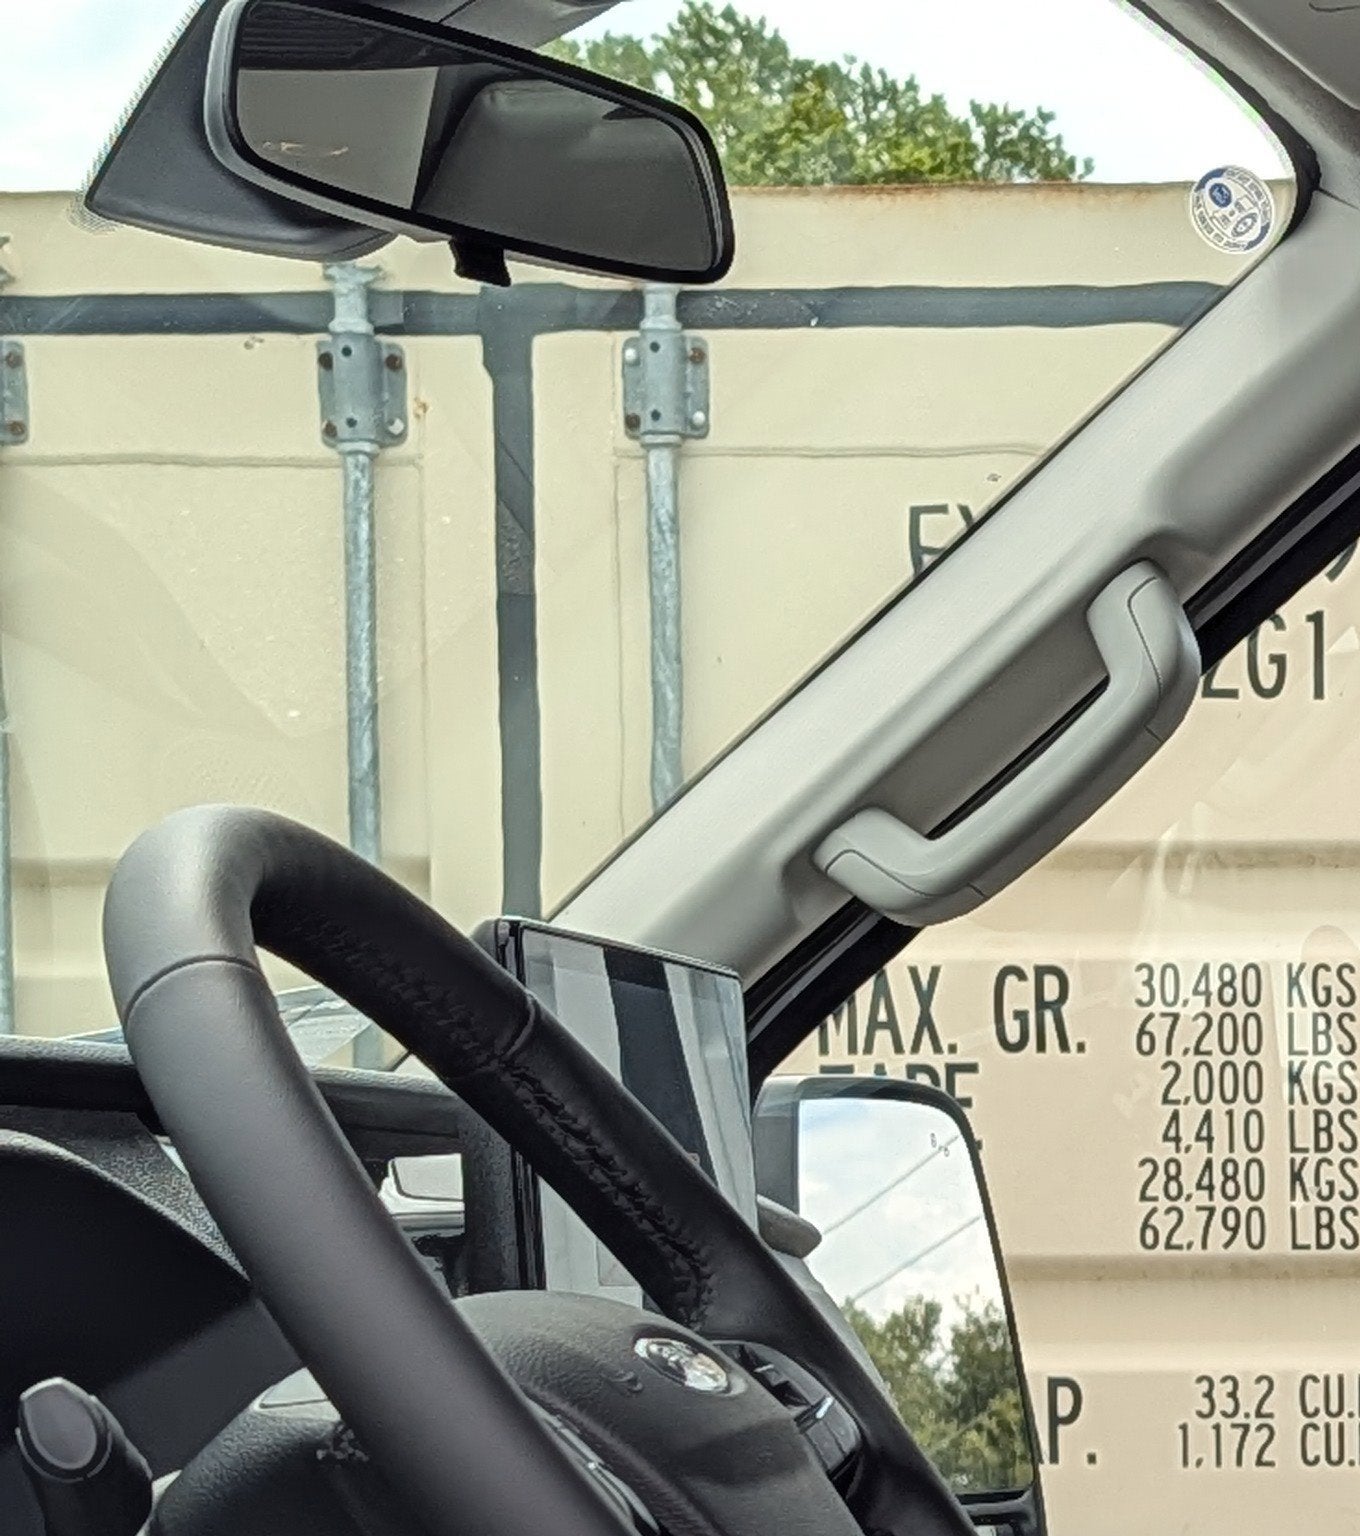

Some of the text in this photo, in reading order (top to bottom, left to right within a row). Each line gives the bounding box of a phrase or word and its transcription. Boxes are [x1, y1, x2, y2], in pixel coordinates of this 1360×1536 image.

[993, 965, 1086, 1054] GR.
[1134, 962, 1263, 1008] 30,480
[1287, 962, 1357, 1008] KGS
[1136, 1011, 1358, 1057] 67,200 LBS
[1160, 1060, 1358, 1106] 2,000 KGS
[1161, 1108, 1359, 1154] 4,410 LBS
[1138, 1156, 1360, 1203] 28,480 KGS
[1139, 1205, 1360, 1251] 62,790 LBS
[1195, 1374, 1275, 1420] 33.2
[1178, 1422, 1276, 1468] 1,172
